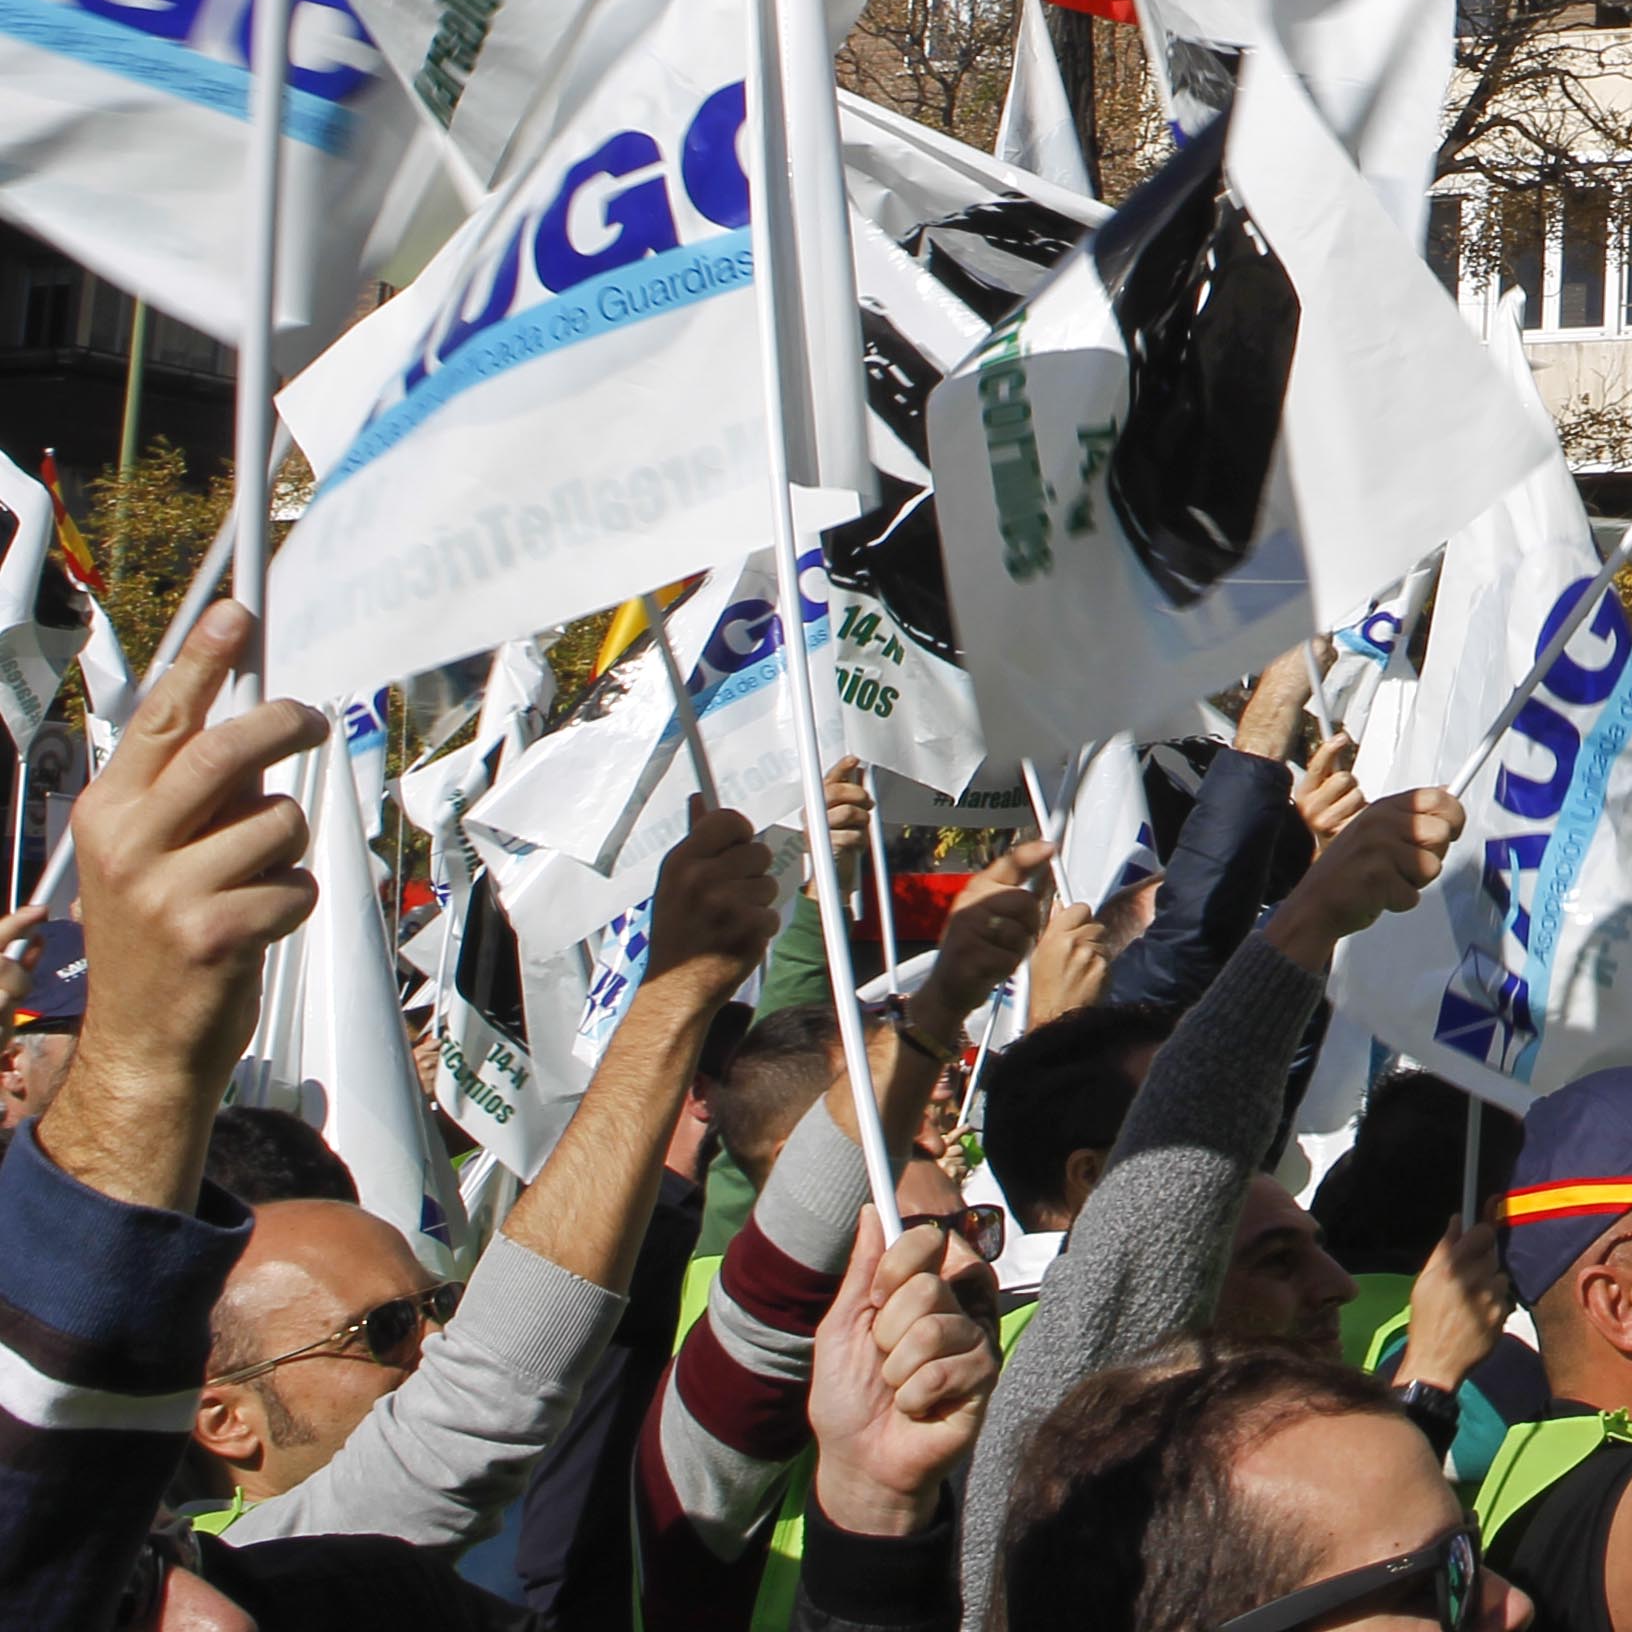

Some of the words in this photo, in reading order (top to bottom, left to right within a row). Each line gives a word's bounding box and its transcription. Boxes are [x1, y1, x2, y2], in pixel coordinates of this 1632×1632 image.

[596, 248, 756, 323] Guardias
[836, 605, 906, 666] 14-N
[486, 1042, 530, 1091] 14-N
